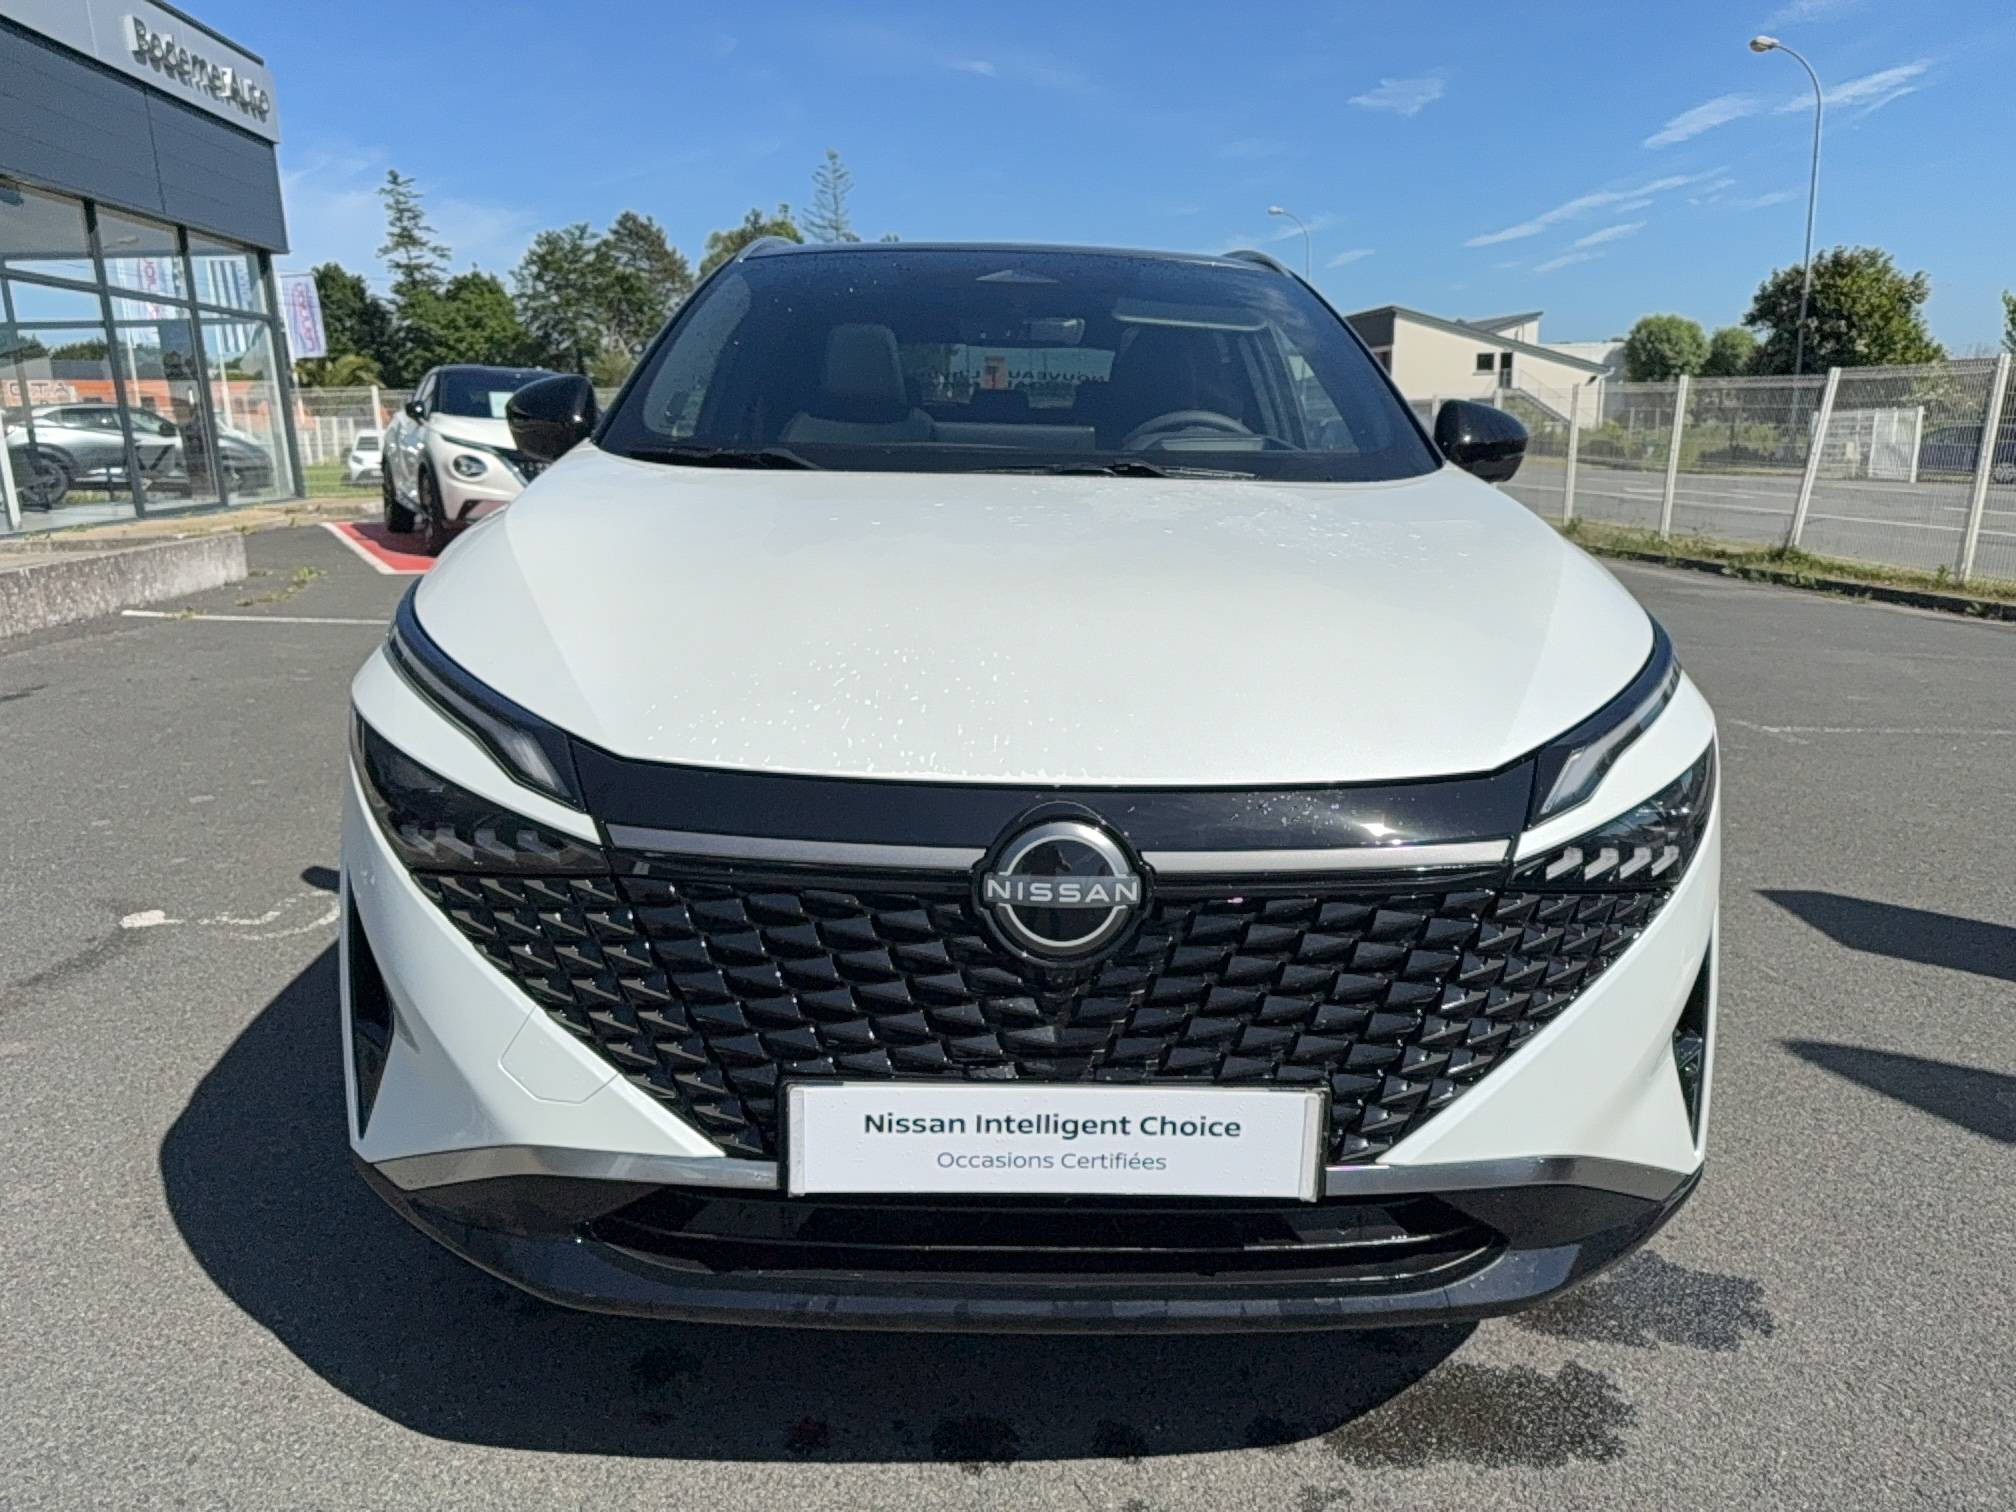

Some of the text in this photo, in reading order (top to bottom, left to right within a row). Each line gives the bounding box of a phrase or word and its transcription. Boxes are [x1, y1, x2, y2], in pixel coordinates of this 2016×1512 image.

[986, 879, 1138, 904] NISSAN
[864, 1112, 1242, 1141] Nissan Intelligent Choice
[936, 1151, 1167, 1171] Occasions Certifiées
